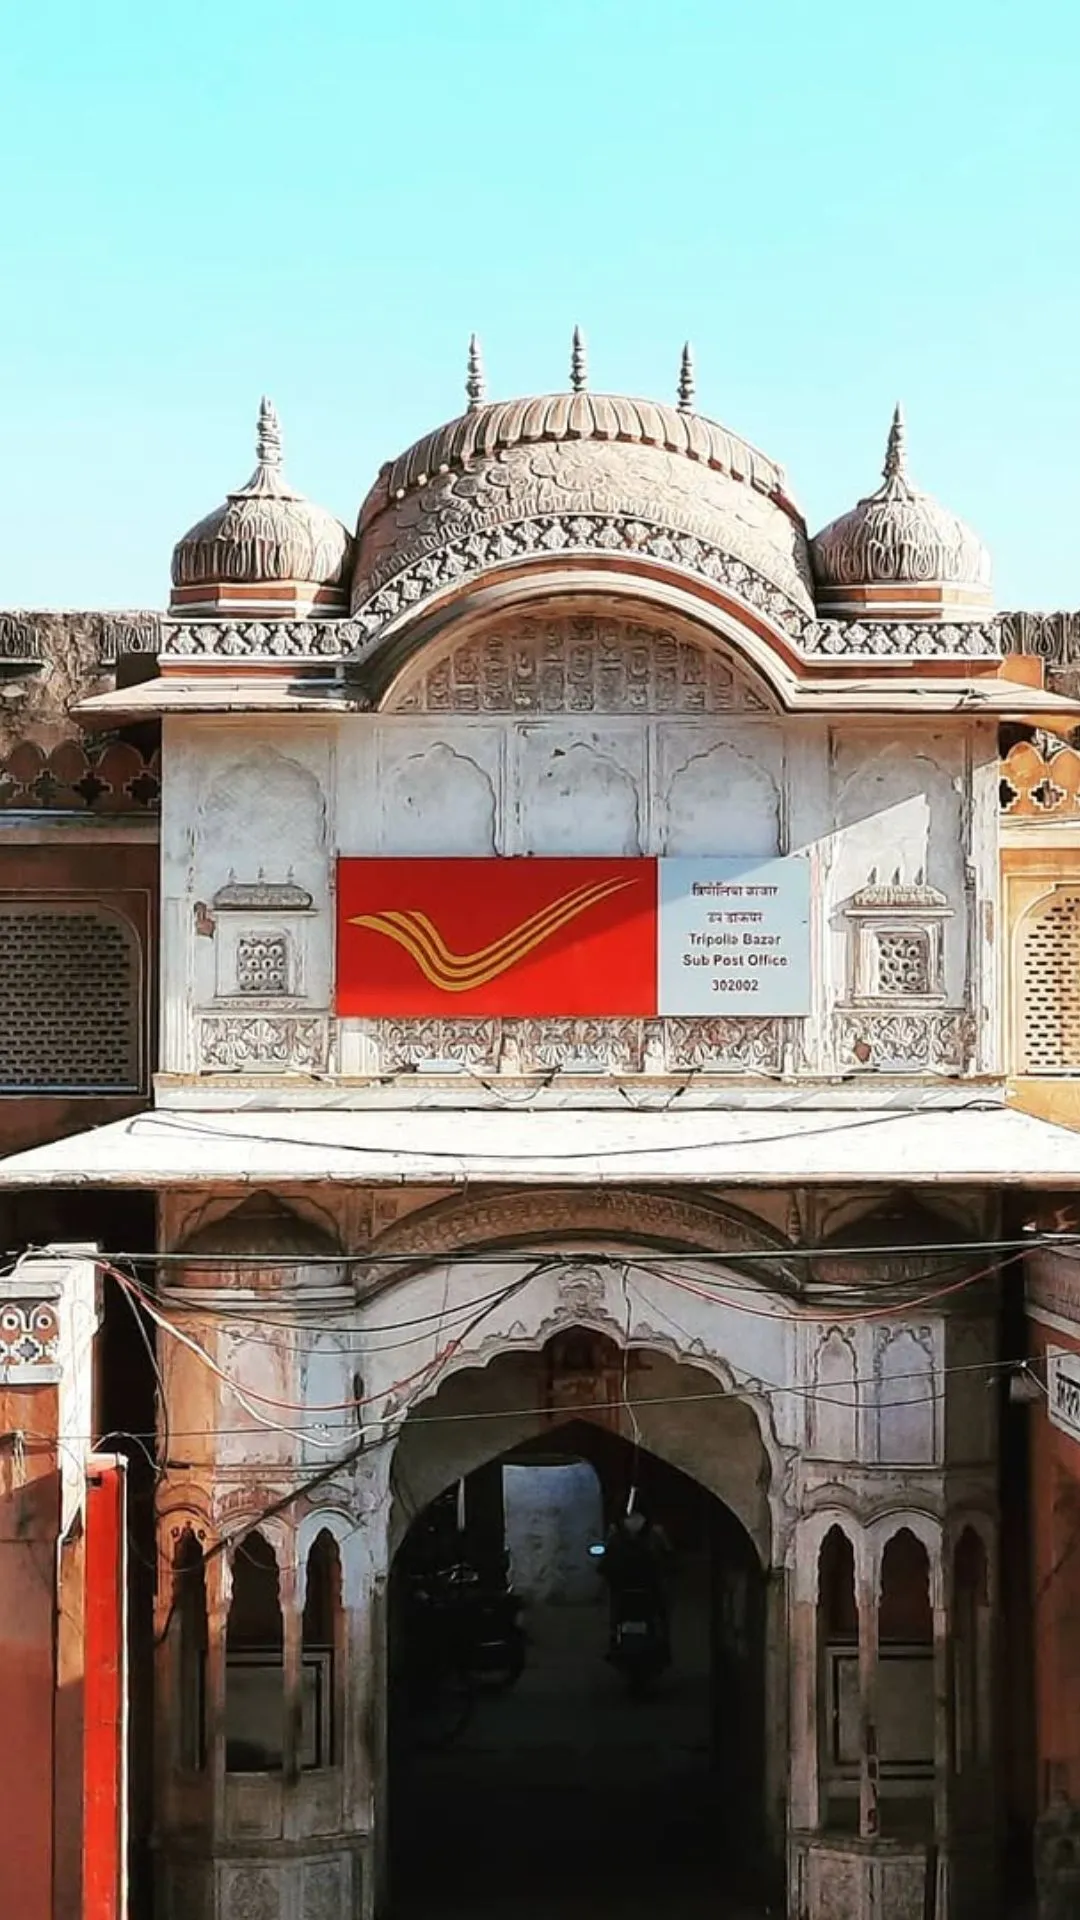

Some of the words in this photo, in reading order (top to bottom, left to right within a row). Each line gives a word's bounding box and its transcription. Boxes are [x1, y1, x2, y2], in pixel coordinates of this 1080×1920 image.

[689, 933, 738, 947] Tripolia
[743, 933, 781, 945] Bazar
[683, 954, 709, 966] Sub
[714, 954, 744, 966] Post
[748, 954, 787, 966] Office
[712, 979, 759, 991] 302002
